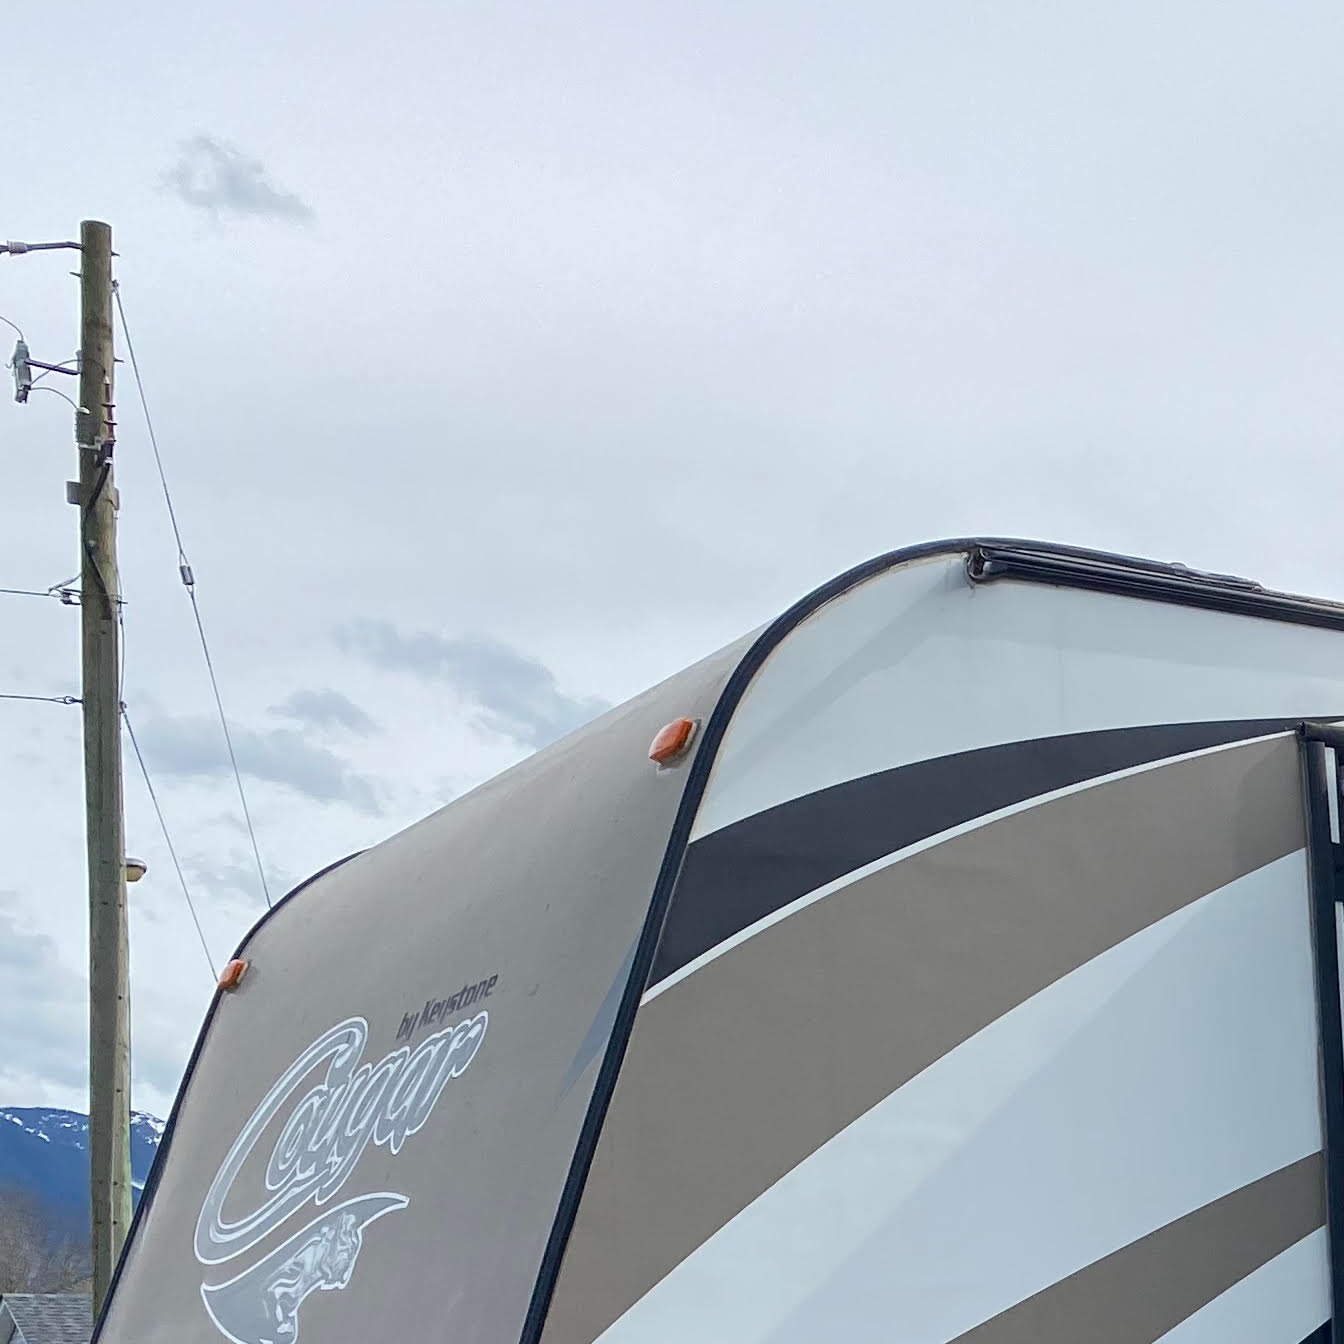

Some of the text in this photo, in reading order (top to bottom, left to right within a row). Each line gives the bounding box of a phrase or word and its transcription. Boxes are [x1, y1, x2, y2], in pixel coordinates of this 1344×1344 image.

[396, 974, 498, 1040] by Keystone
[193, 1010, 489, 1265] Cougar
